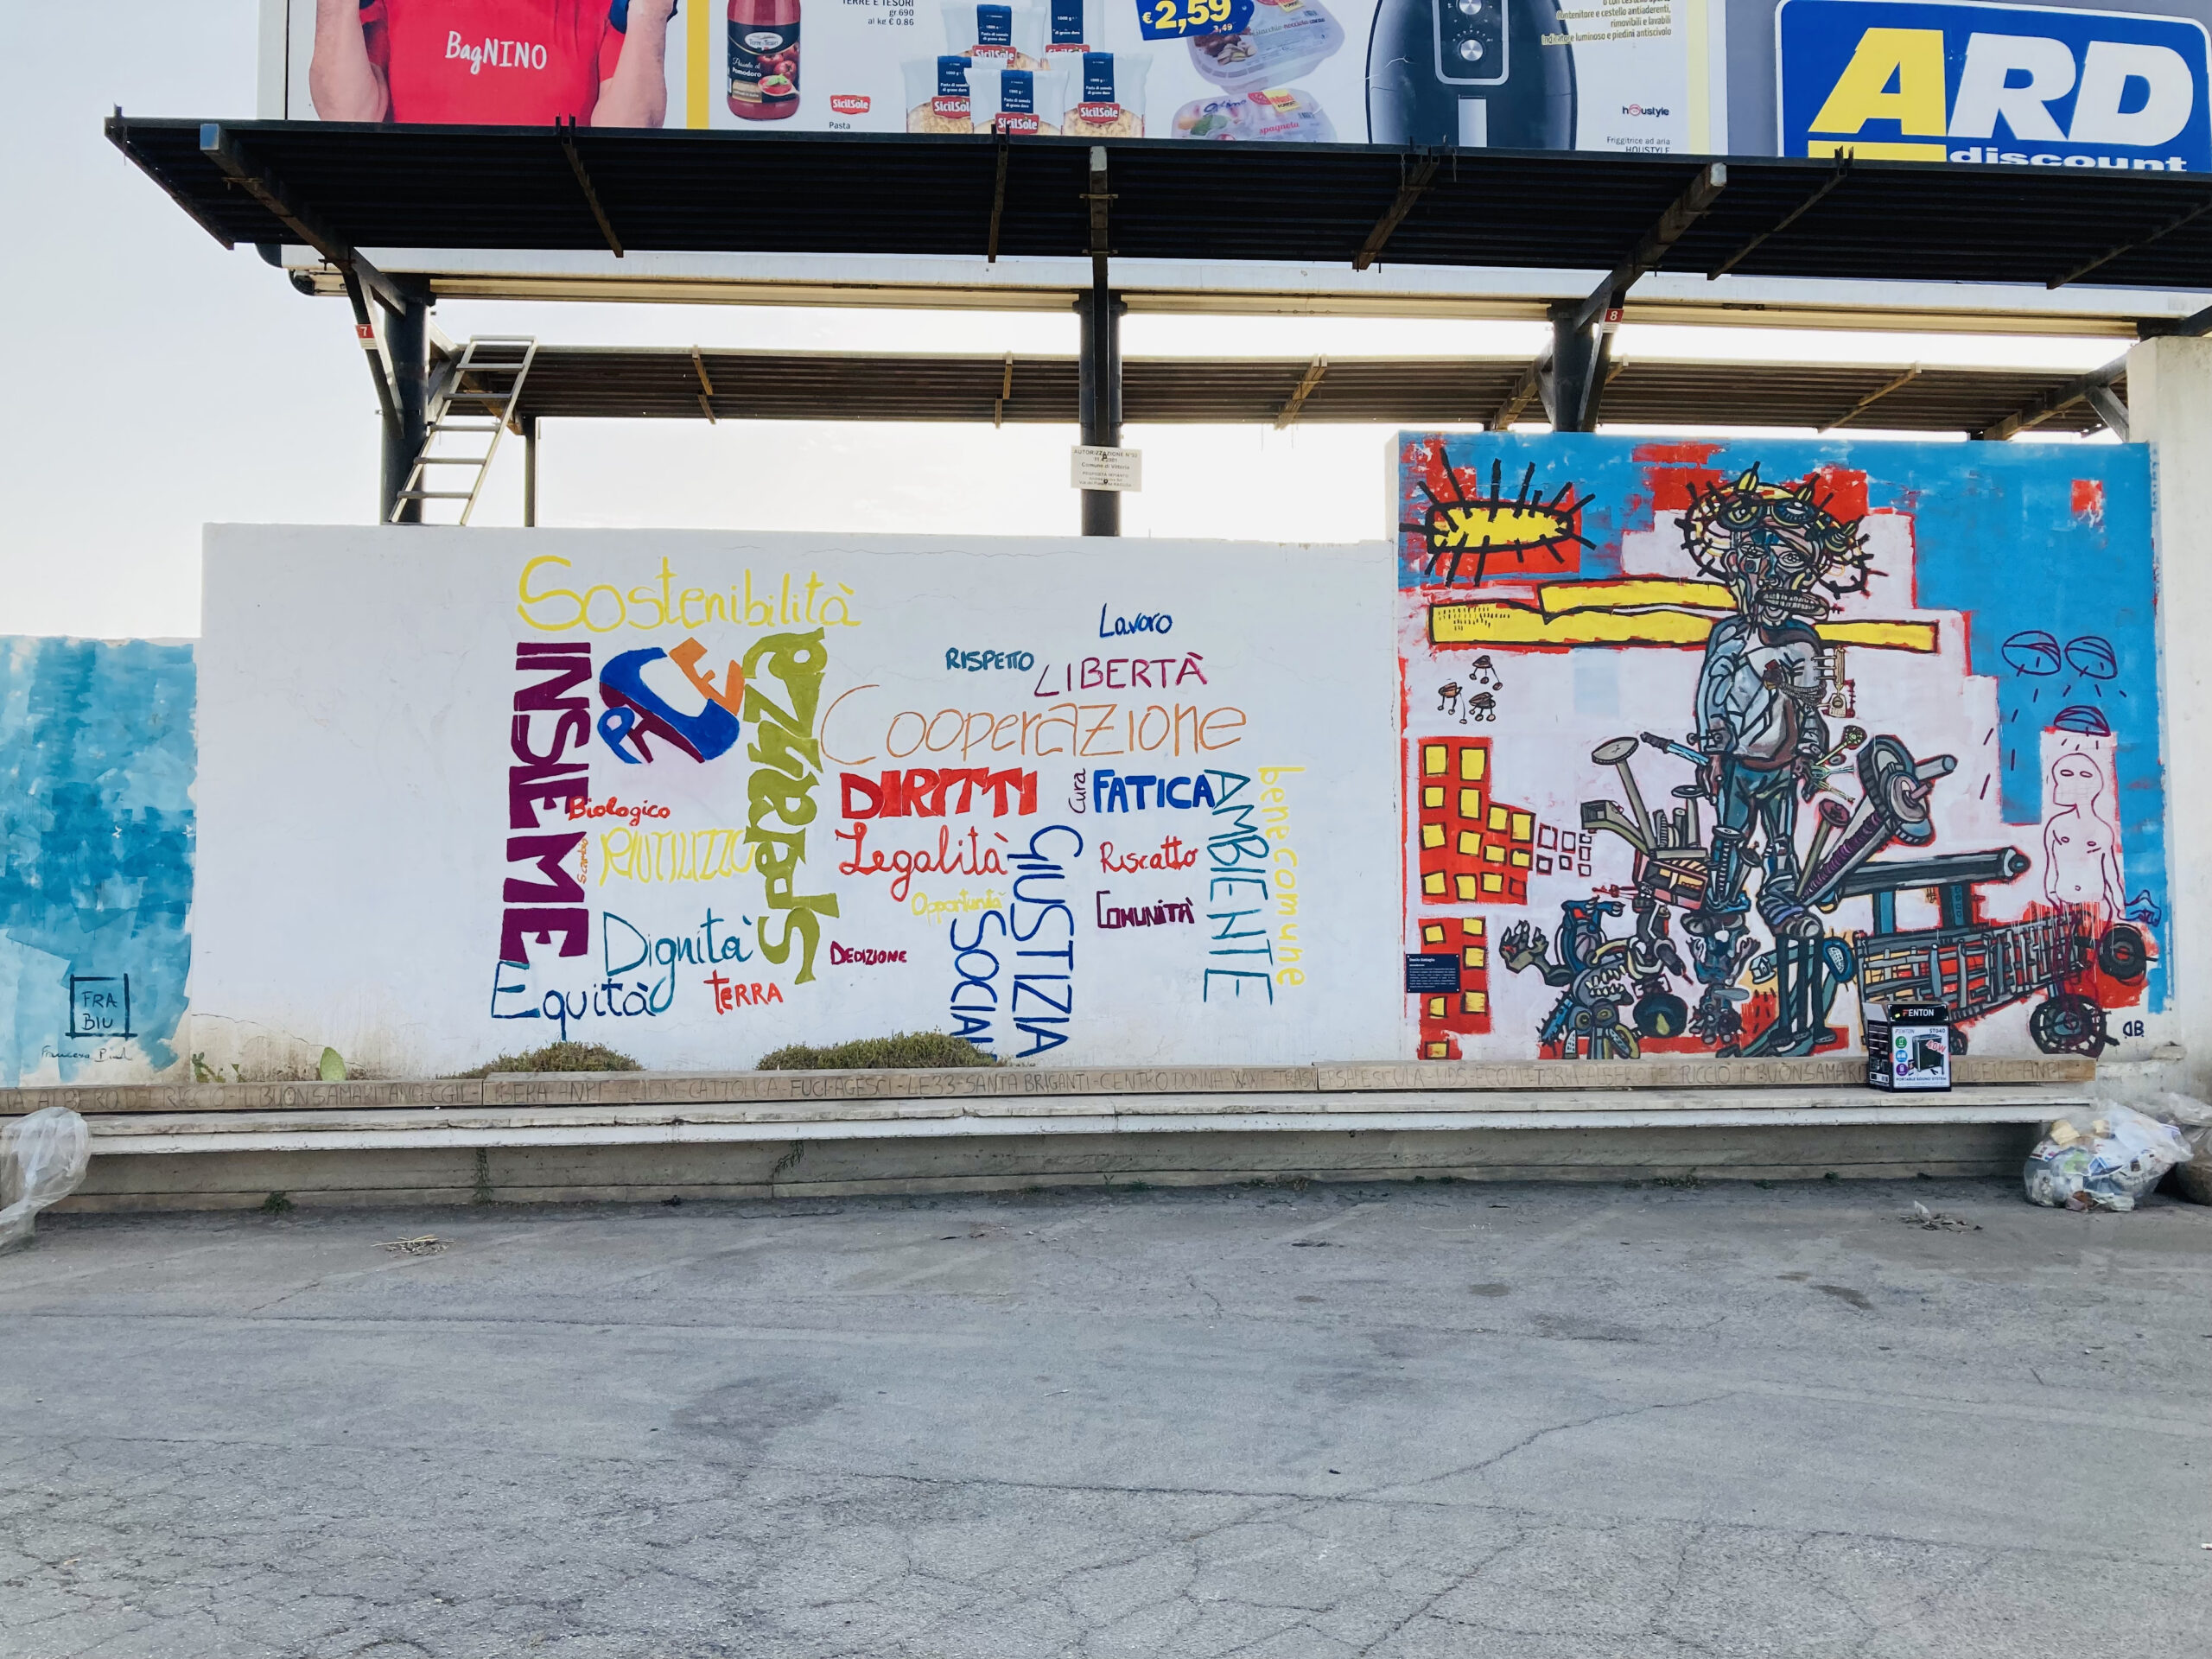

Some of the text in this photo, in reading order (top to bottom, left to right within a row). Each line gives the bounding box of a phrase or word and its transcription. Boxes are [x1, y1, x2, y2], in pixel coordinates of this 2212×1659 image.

[889, 9, 897, 17] gr
[1142, 11, 1154, 24] €
[1154, 0, 1231, 35] 2,59
[1601, 8, 1626, 17] cestello
[1611, 17, 1641, 28] rimovibili
[1648, 16, 1671, 25] lavabili
[1575, 31, 1605, 41] luminoso
[1612, 29, 1635, 41] piedini
[1637, 28, 1672, 38] antiscivolo
[445, 30, 547, 75] BagNINO
[832, 99, 868, 110] SicilSole
[1808, 28, 2194, 146] ARD
[934, 101, 969, 112] SicilSol
[1080, 106, 1119, 118] SicilSole
[1622, 104, 1669, 118] houstyle
[829, 121, 851, 130] Pasta
[1606, 136, 1643, 145] Friggitrice
[1948, 147, 2188, 172] discount
[359, 326, 368, 337] 7
[1610, 310, 1618, 321] 8
[518, 556, 861, 632] Sostenibilità
[1100, 603, 1173, 639] Lavoro
[945, 647, 1035, 672] RISPETTO
[1034, 652, 1209, 697] LIBERTÀ
[499, 642, 593, 963] INSIEME
[839, 766, 1039, 819] DIRITTI
[1067, 767, 1086, 814] Cura
[1093, 769, 1216, 812] FATICA
[568, 796, 671, 826] Biologico
[835, 822, 1009, 902] Legalità
[1099, 835, 1198, 873] Riscatto
[1204, 768, 1274, 1005] AMBIENTE
[1257, 766, 1306, 987] bene comune
[1007, 824, 1084, 1058] GIUSTIZIA
[603, 907, 753, 1013] Dignità
[82, 991, 118, 1008] FRA
[491, 960, 658, 1041] Equità
[950, 910, 1007, 1063] SOCIAL
[82, 1013, 113, 1030] BIU
[1903, 1008, 1935, 1017] FENTON
[260, 1086, 308, 1107] BUON
[964, 1073, 1018, 1094] SANTA
[1024, 1071, 1090, 1093] BRIGANTI
